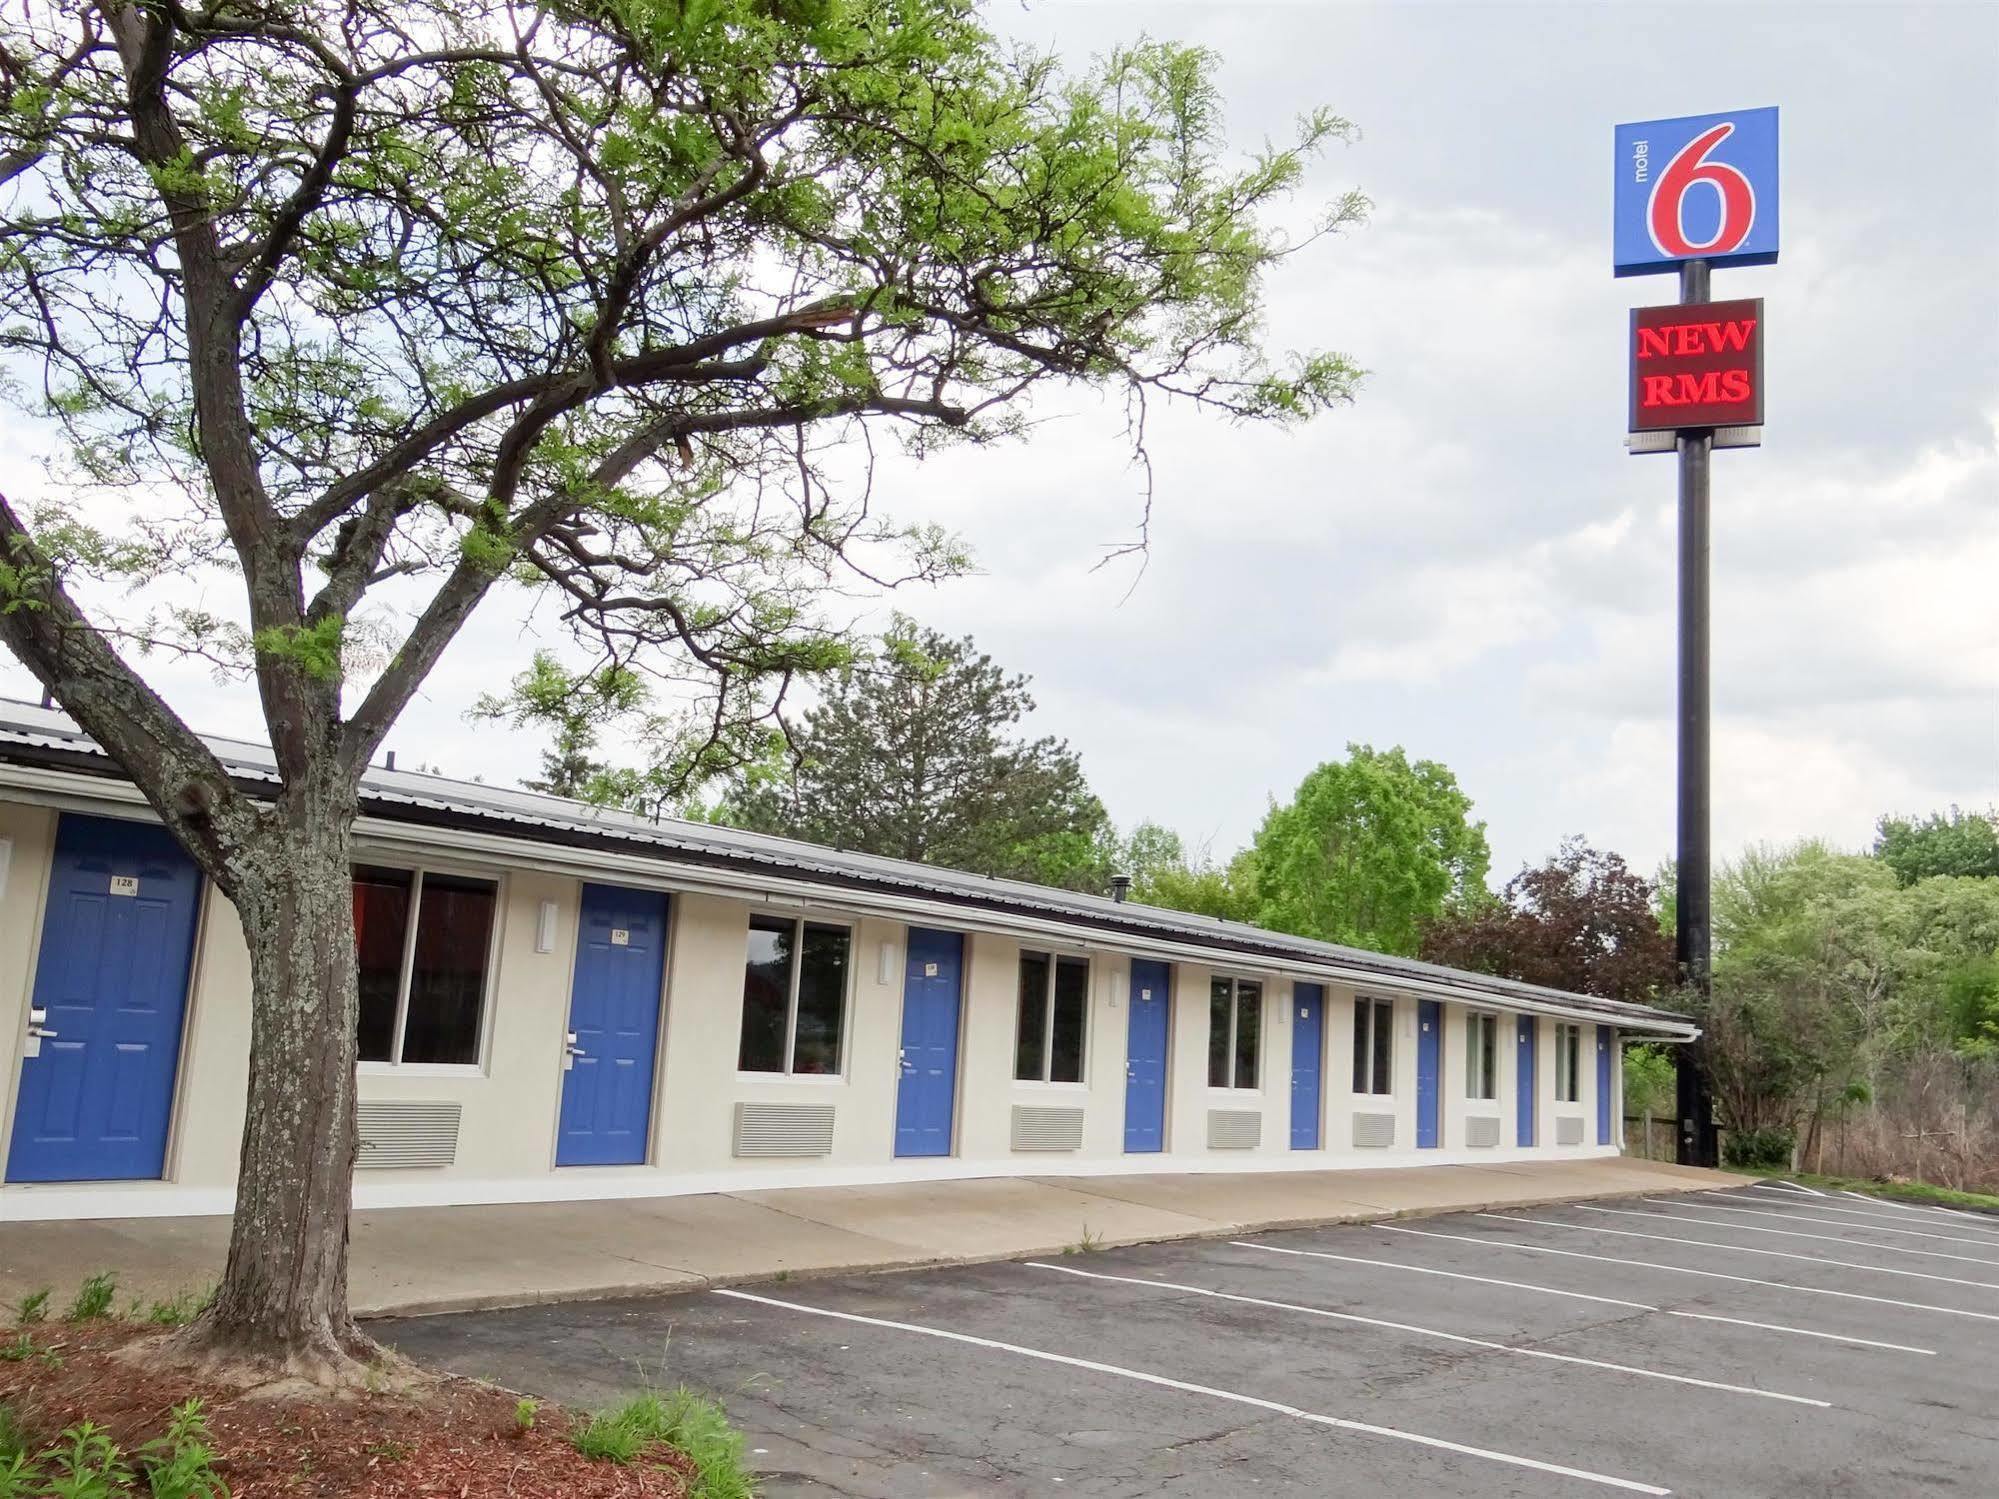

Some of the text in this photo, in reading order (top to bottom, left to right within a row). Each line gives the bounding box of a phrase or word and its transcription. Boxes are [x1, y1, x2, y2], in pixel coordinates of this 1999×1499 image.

[1632, 140, 1648, 183] motel
[1647, 122, 1756, 257] 6
[1638, 320, 1757, 358] NEW
[1642, 370, 1751, 408] RMS
[117, 878, 133, 887] 128
